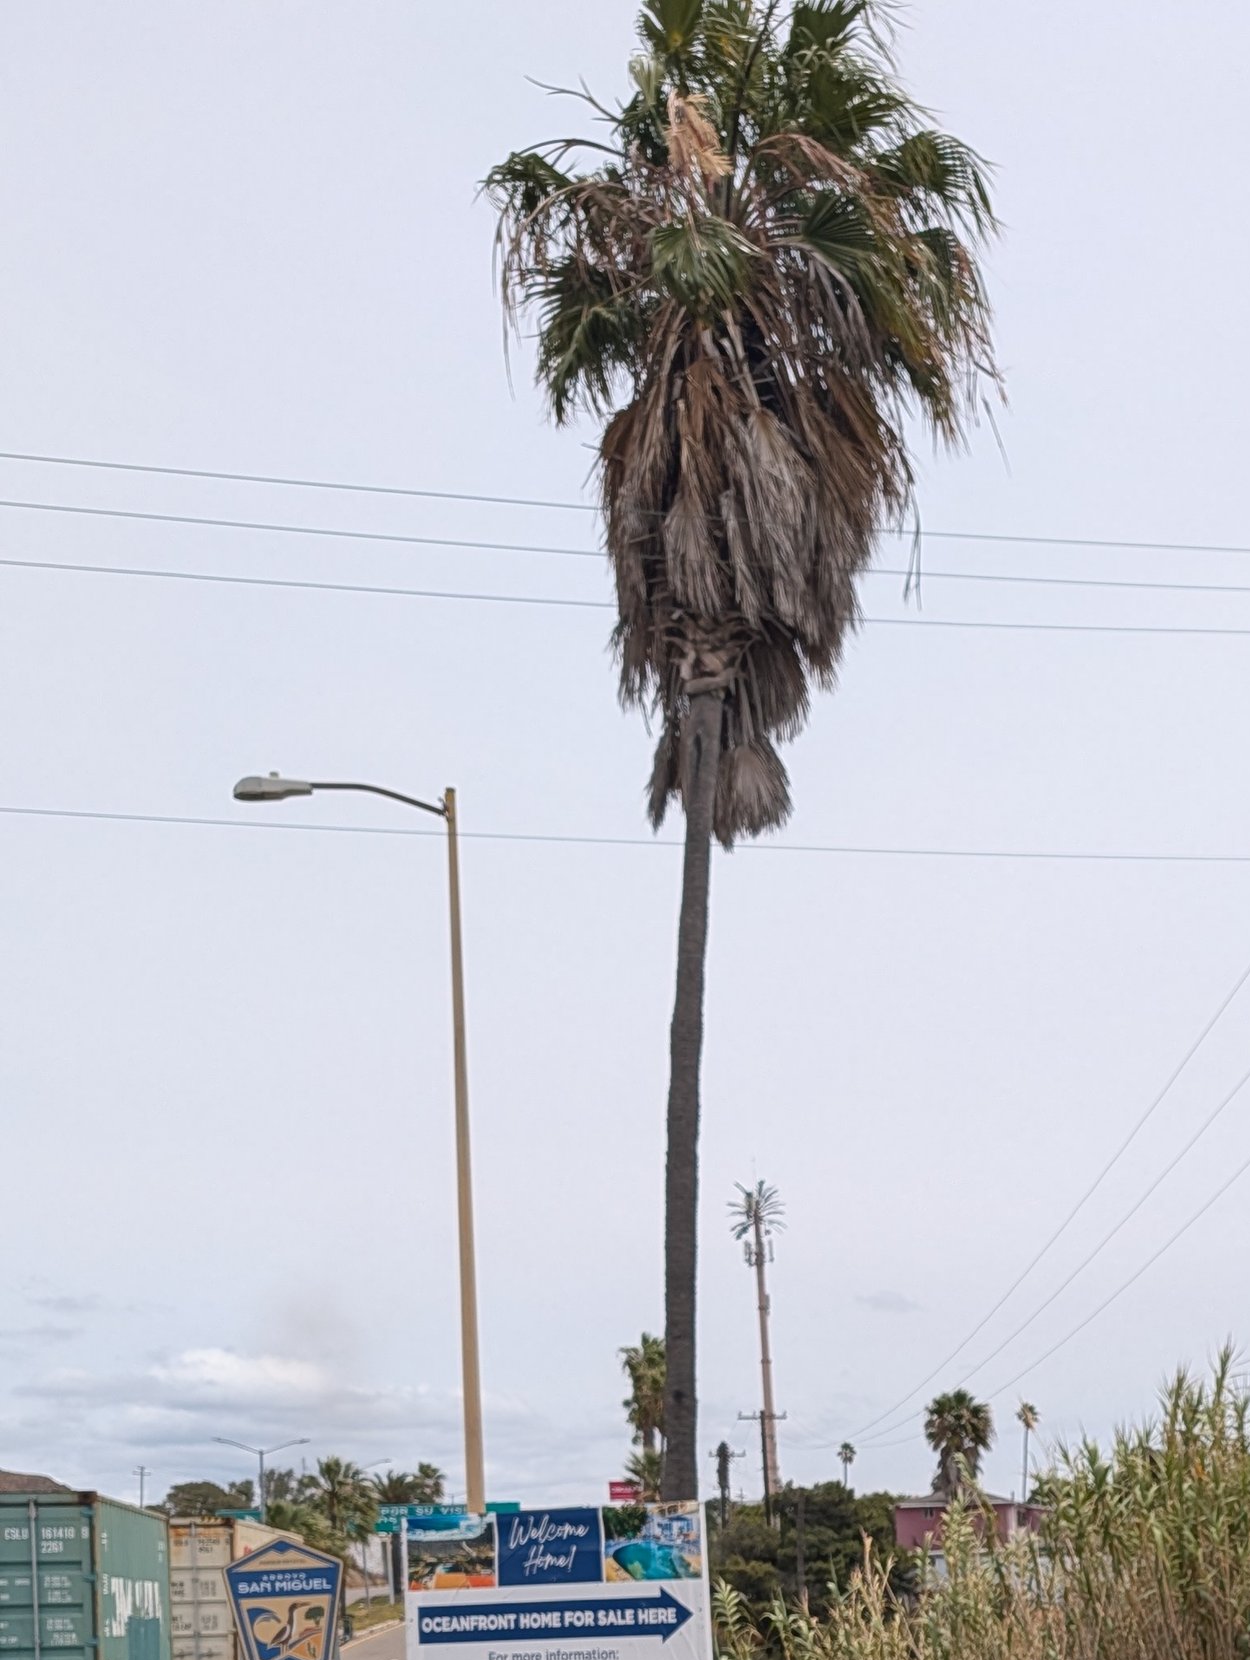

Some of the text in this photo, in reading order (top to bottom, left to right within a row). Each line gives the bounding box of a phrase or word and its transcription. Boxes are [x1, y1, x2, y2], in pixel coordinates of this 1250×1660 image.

[509, 1513, 589, 1549] Welcome
[524, 1544, 577, 1577] Home!
[238, 1578, 332, 1594] SAN MIGUEL
[421, 1607, 677, 1634] OCEANFRONT HOME FOR SALE HERE
